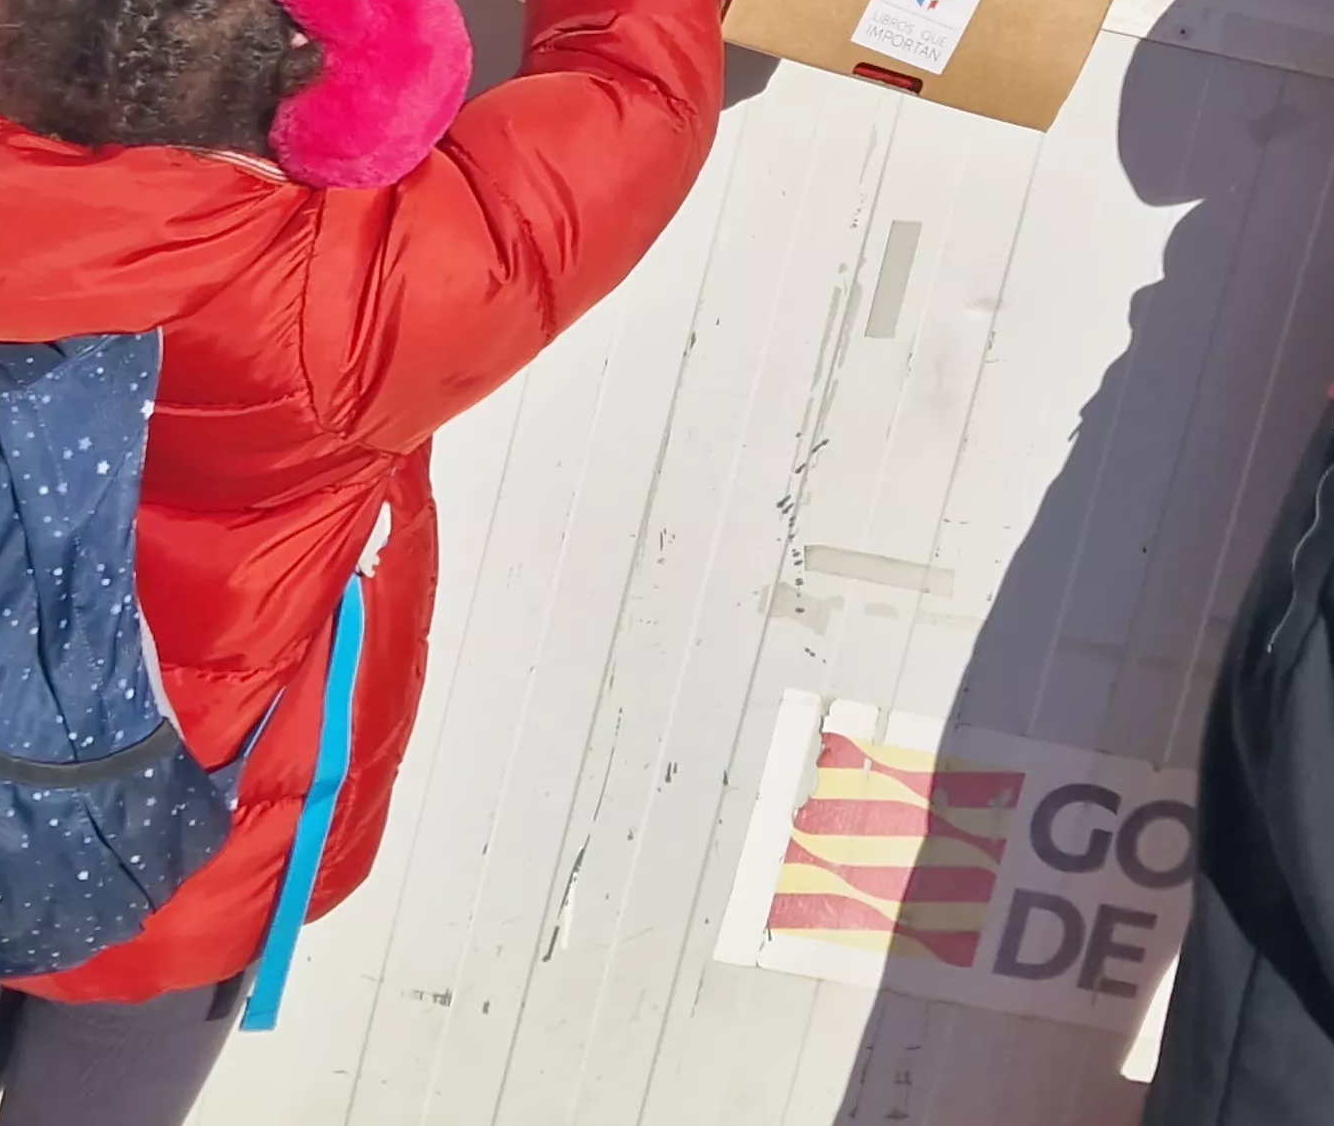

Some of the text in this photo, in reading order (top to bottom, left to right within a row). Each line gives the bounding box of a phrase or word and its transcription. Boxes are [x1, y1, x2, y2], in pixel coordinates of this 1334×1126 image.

[865, 24, 942, 62] IMPORTAN
[872, 12, 948, 48] LIBROS QUE
[992, 887, 1158, 999] DE
